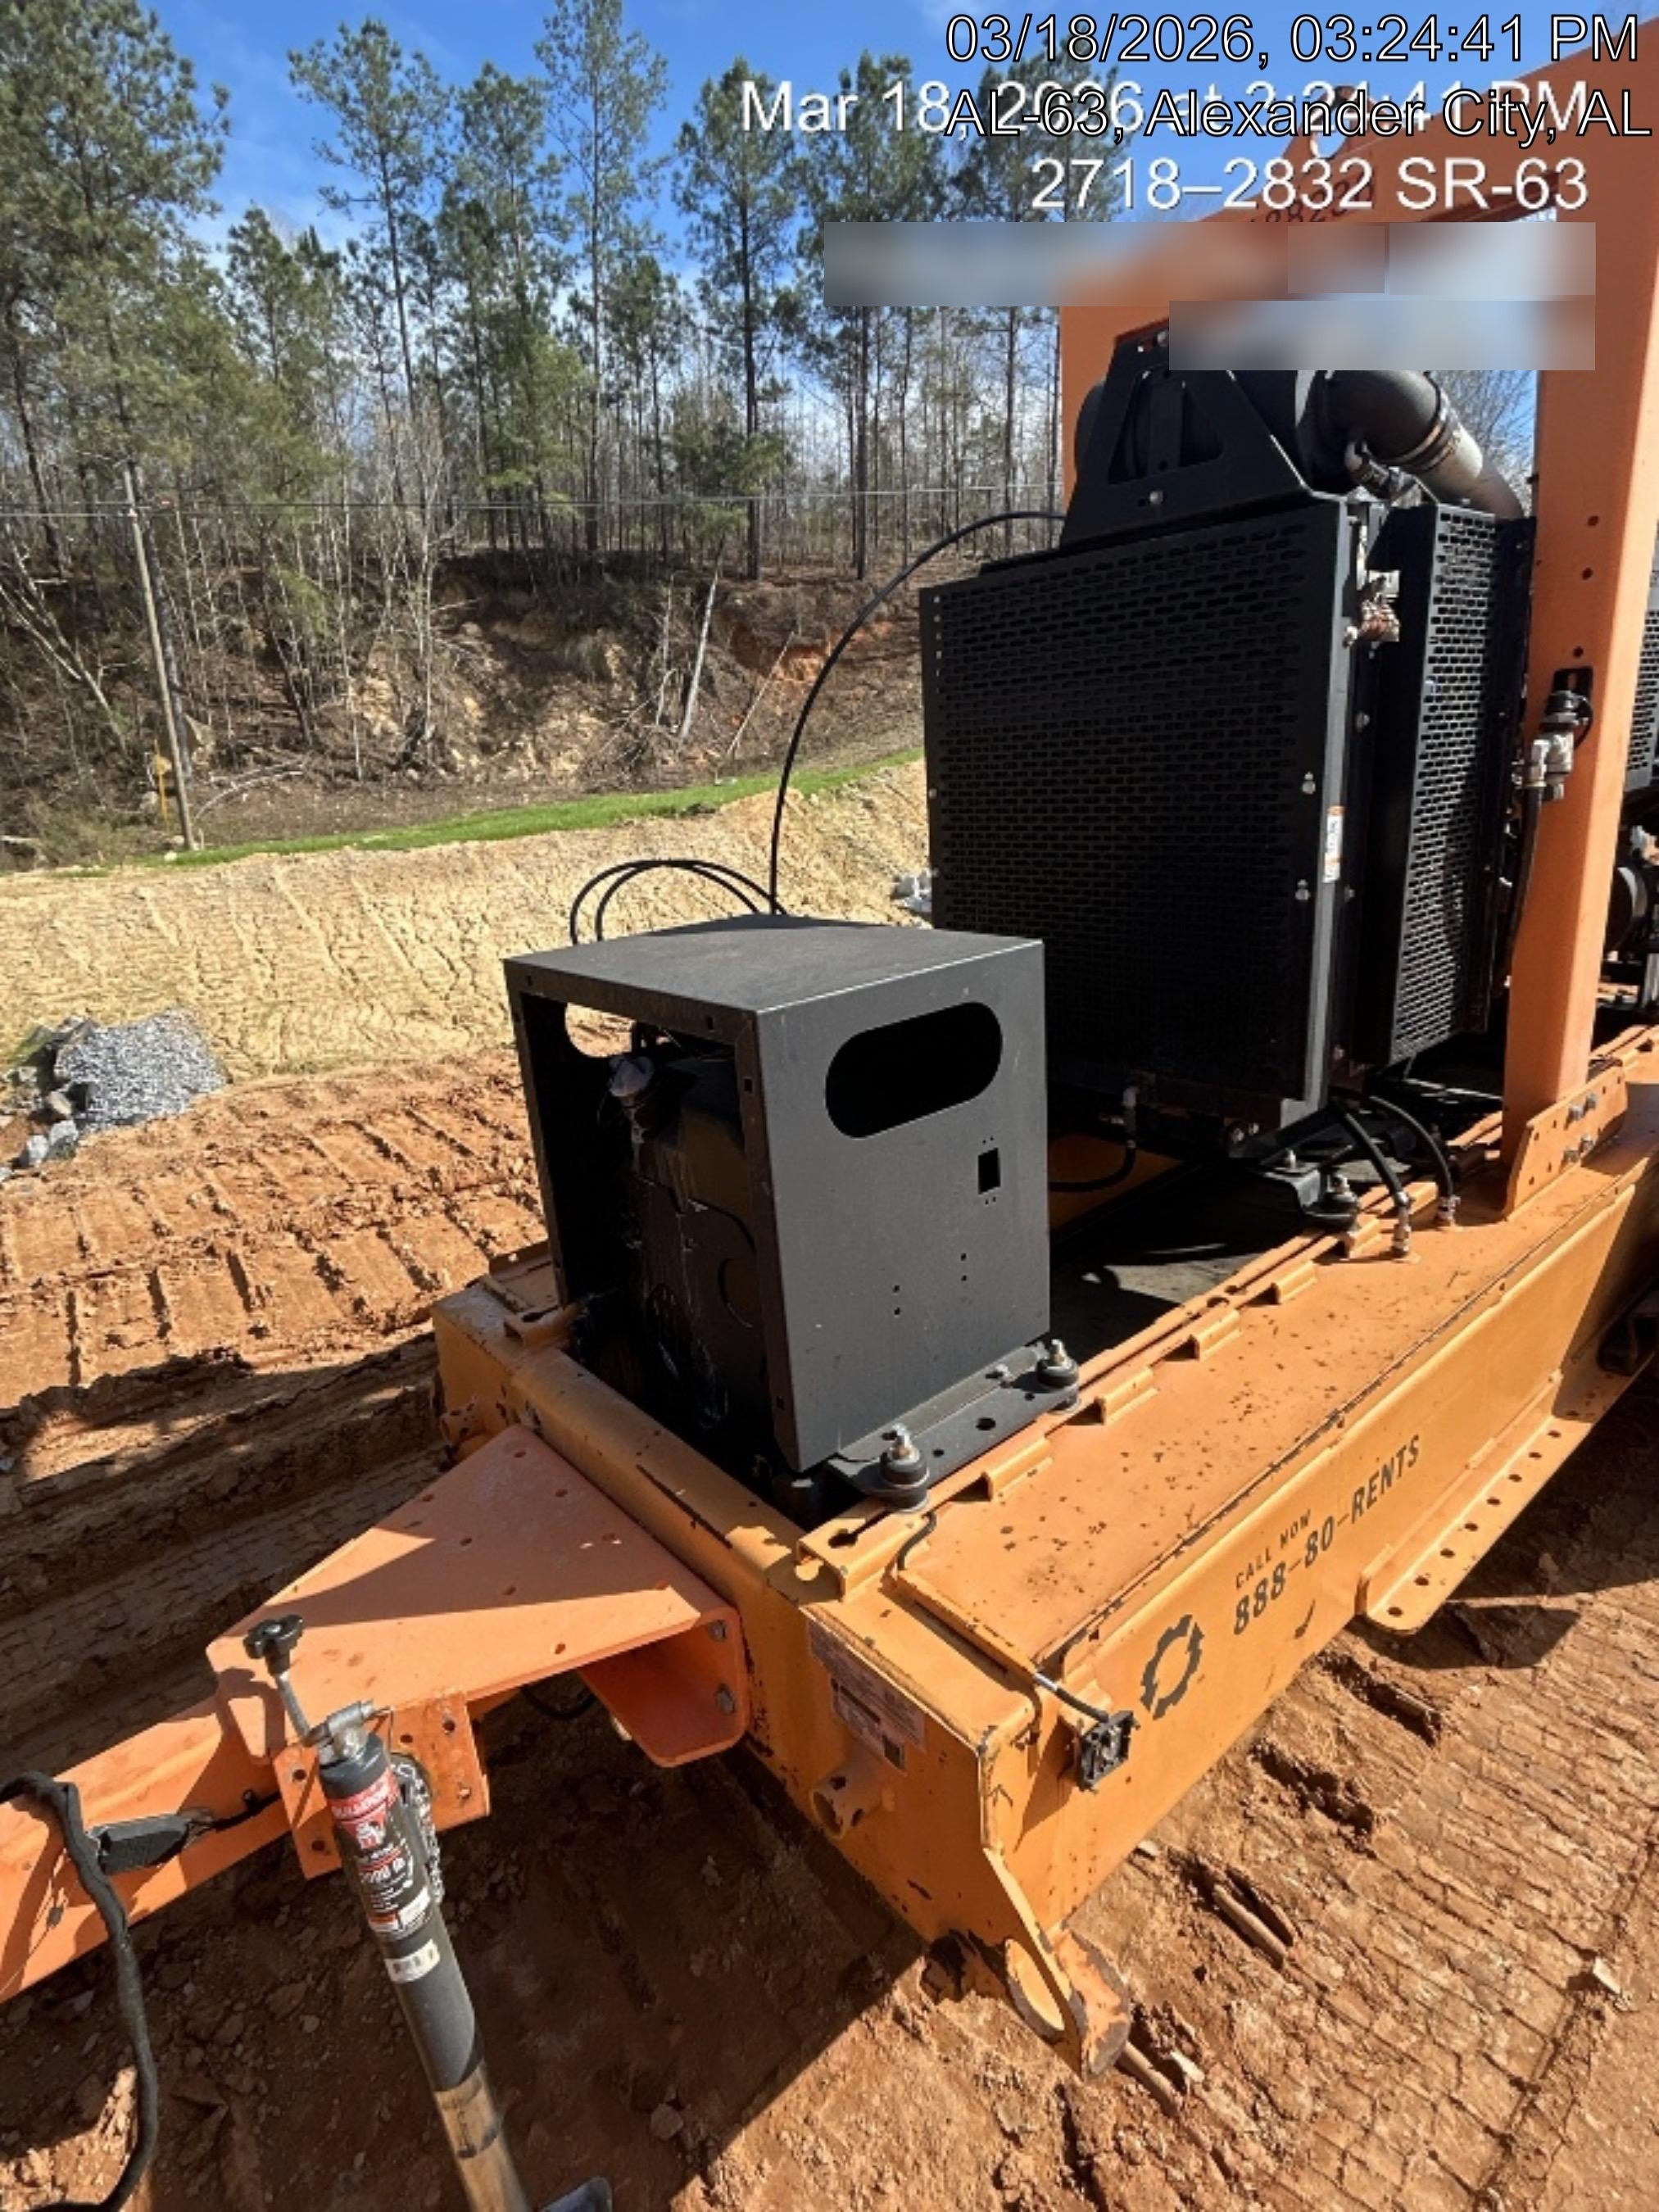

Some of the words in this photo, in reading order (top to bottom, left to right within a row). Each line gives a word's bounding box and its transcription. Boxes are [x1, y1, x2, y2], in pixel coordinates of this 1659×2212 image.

[1233, 1434, 1420, 1635] 888-80-RENTS
[1235, 1548, 1271, 1590] CALL
[1280, 1508, 1312, 1549] NOW
